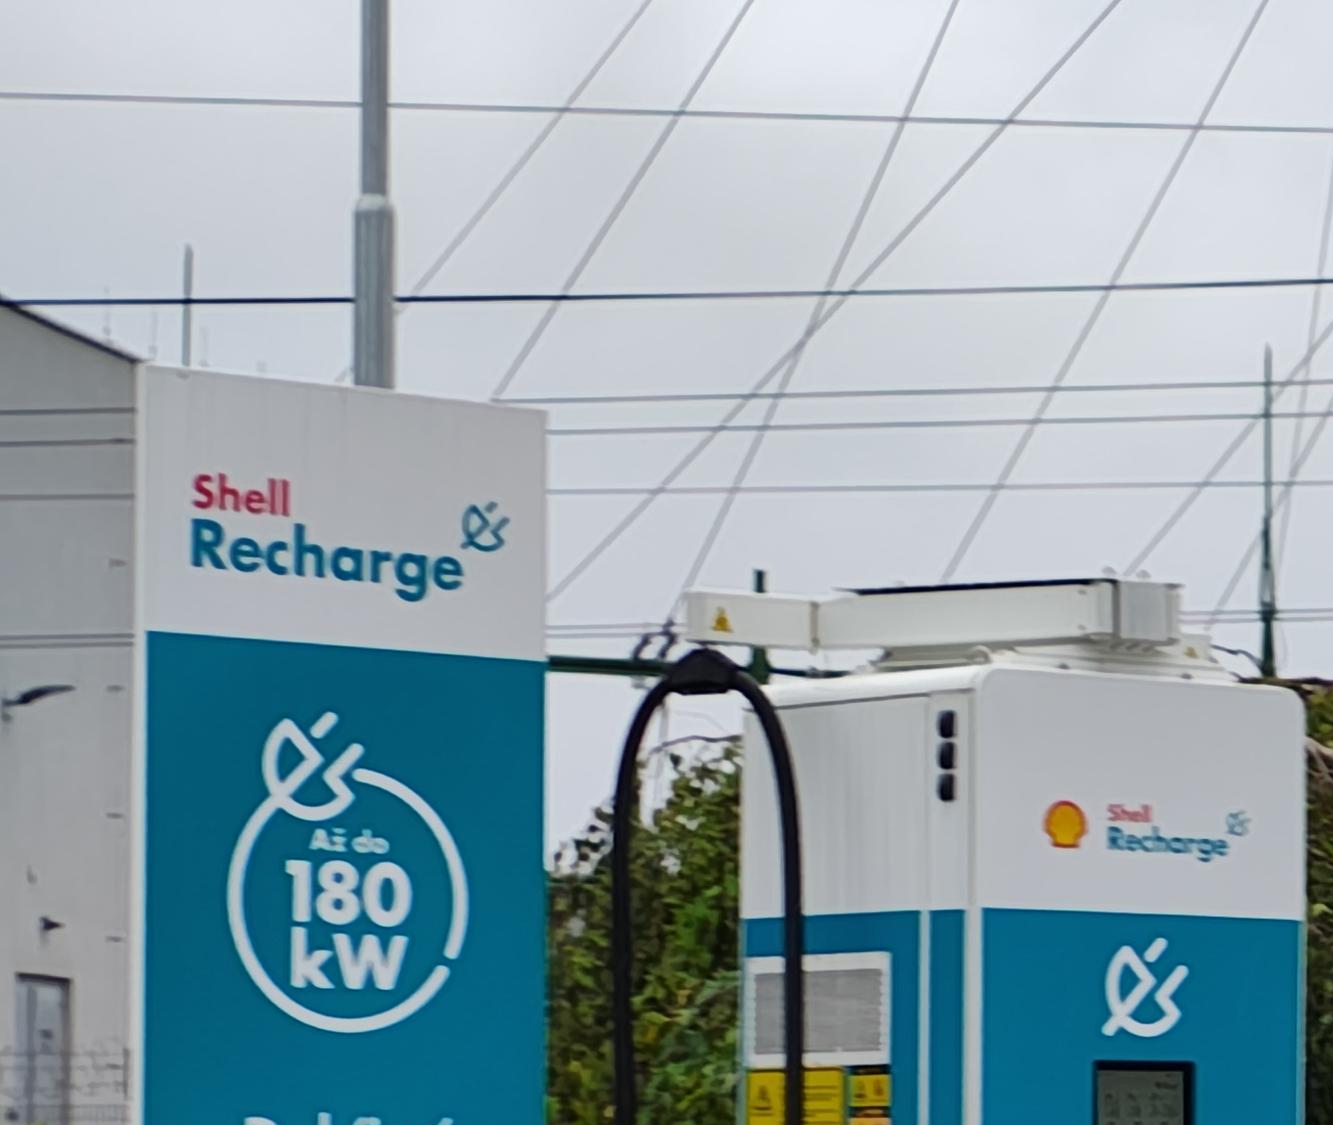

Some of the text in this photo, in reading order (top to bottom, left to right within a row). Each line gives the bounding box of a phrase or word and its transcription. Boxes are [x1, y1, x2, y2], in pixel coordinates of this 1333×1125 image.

[191, 473, 290, 517] Shell
[190, 518, 465, 602] Recharge
[309, 827, 390, 854] Až do
[1107, 826, 1229, 862] Recharge
[285, 860, 413, 927] 180
[290, 926, 409, 990] kW
